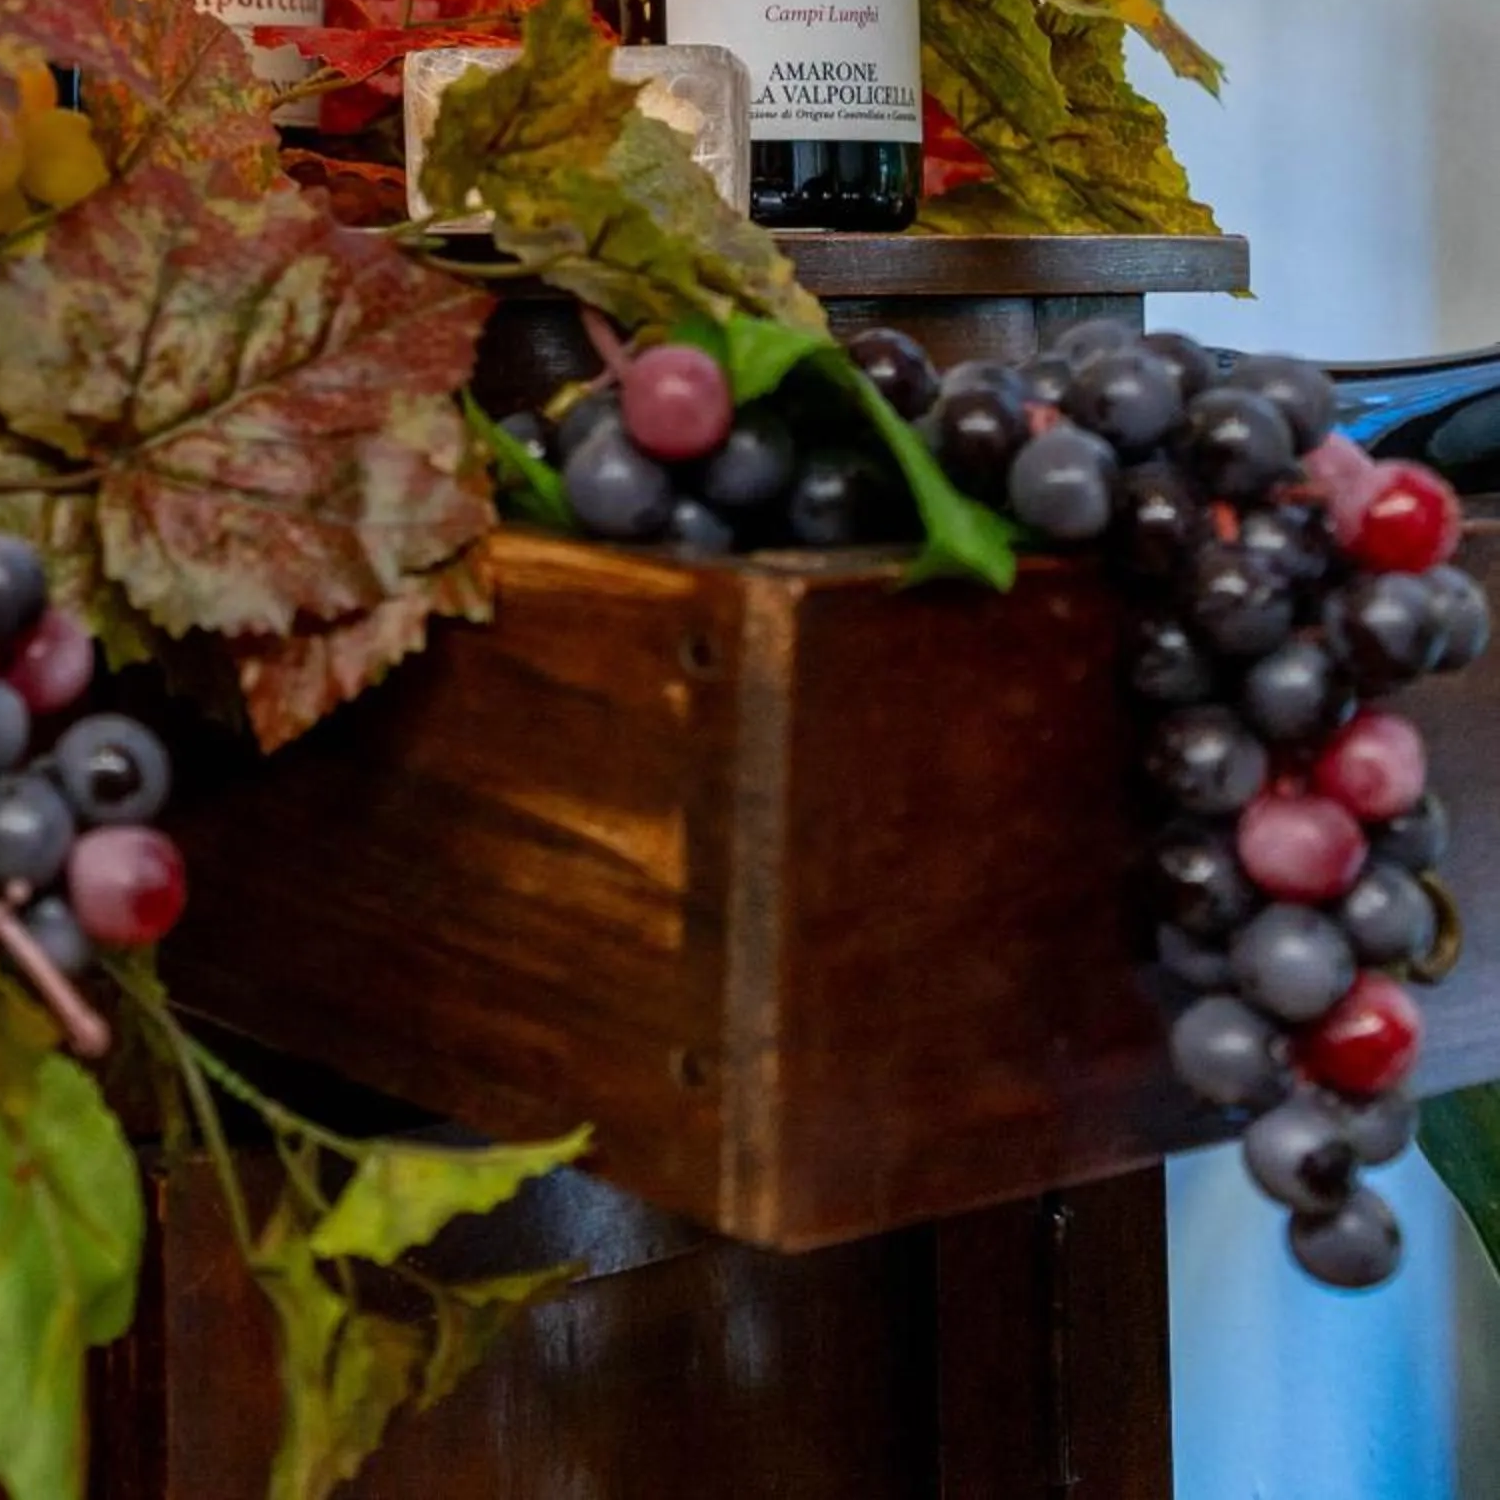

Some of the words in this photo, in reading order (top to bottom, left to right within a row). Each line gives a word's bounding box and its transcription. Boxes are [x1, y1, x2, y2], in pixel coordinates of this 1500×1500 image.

[765, 4, 825, 28] Campi
[828, 4, 880, 30] Lunghi
[769, 61, 879, 83] AMARONE
[781, 85, 916, 108] VALPOLICELLA
